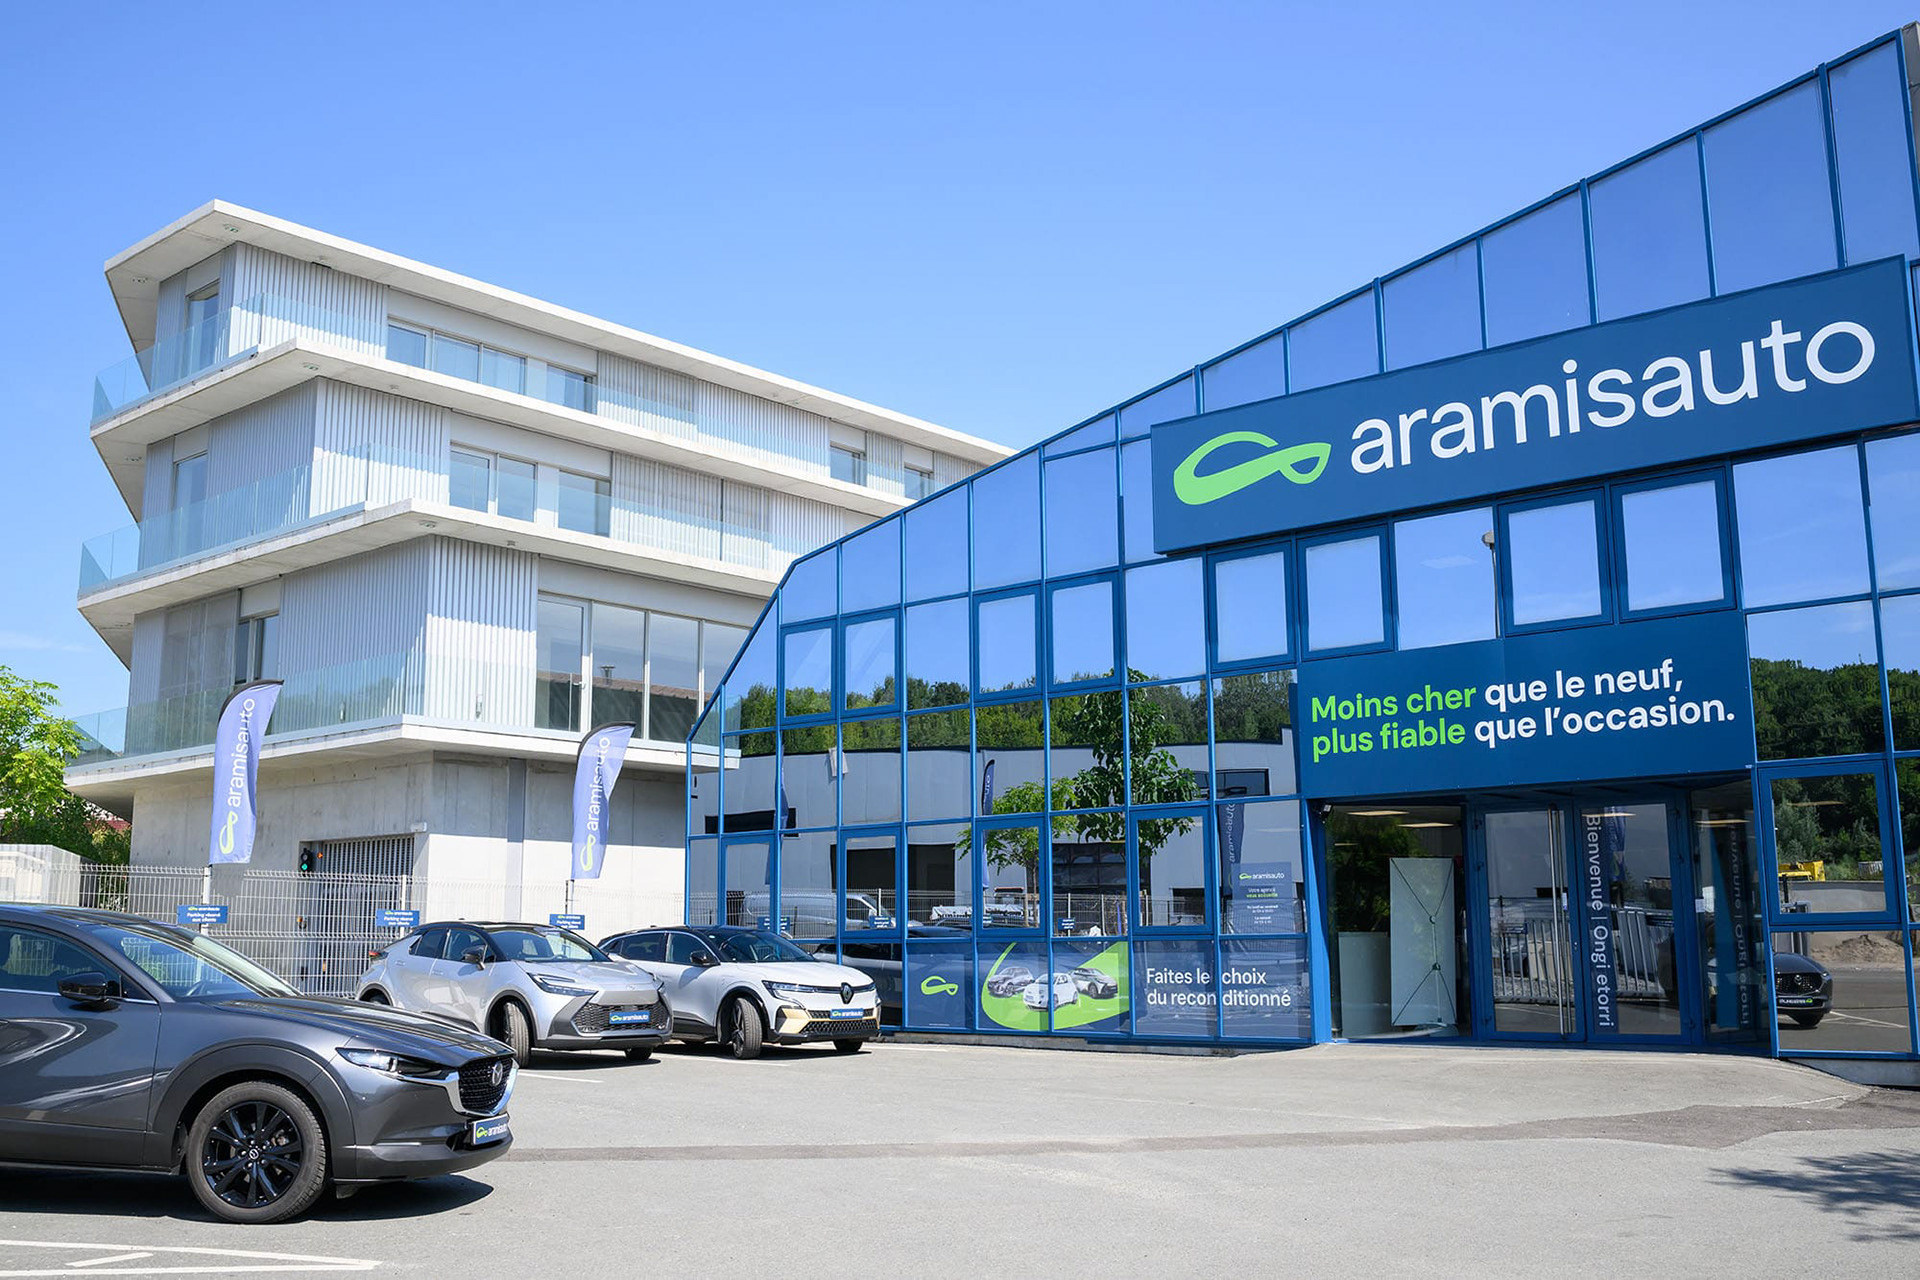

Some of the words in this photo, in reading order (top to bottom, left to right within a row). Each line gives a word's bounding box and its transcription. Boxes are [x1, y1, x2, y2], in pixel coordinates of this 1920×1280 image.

[1351, 319, 1876, 475] aramisauto
[1311, 692, 1399, 723] Moins
[1406, 684, 1477, 713] cher
[1485, 680, 1547, 713] que
[1554, 670, 1585, 699] le
[1594, 658, 1684, 695] neuf,
[227, 698, 256, 808] aramisauto
[1312, 727, 1374, 763] plus
[1379, 717, 1466, 750] fiable
[1474, 716, 1537, 749] que
[1544, 695, 1735, 737] l’occasion.
[1252, 872, 1285, 880] aramisauto
[1586, 815, 1604, 911] Bienvenue
[1146, 967, 1193, 984] Faites
[1196, 967, 1210, 984] le
[1222, 967, 1267, 985] choix
[1591, 925, 1611, 969] Ongi
[1147, 988, 1167, 1006] du
[1596, 974, 1614, 1026] etorri
